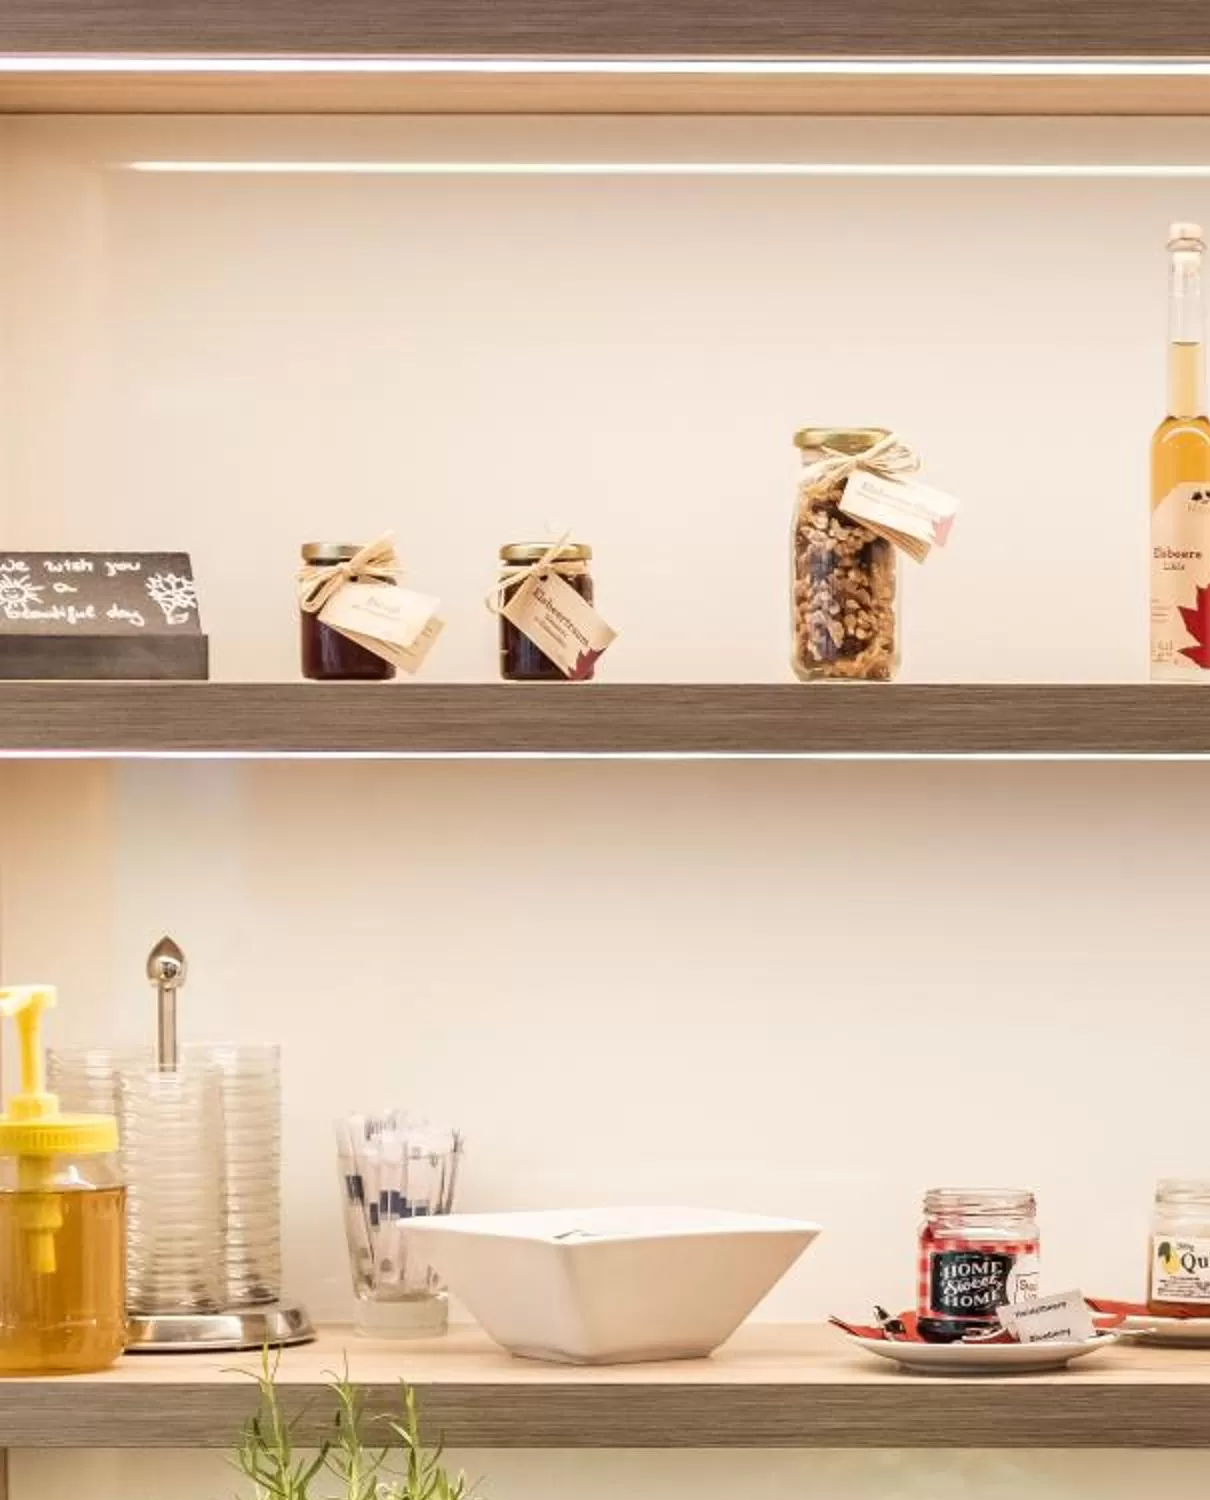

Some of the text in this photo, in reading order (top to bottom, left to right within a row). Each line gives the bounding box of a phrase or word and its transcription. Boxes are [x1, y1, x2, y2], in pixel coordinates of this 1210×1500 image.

[43, 558, 94, 573] wish
[104, 561, 141, 577] you
[106, 602, 145, 627] day
[941, 1261, 1003, 1280] HOME
